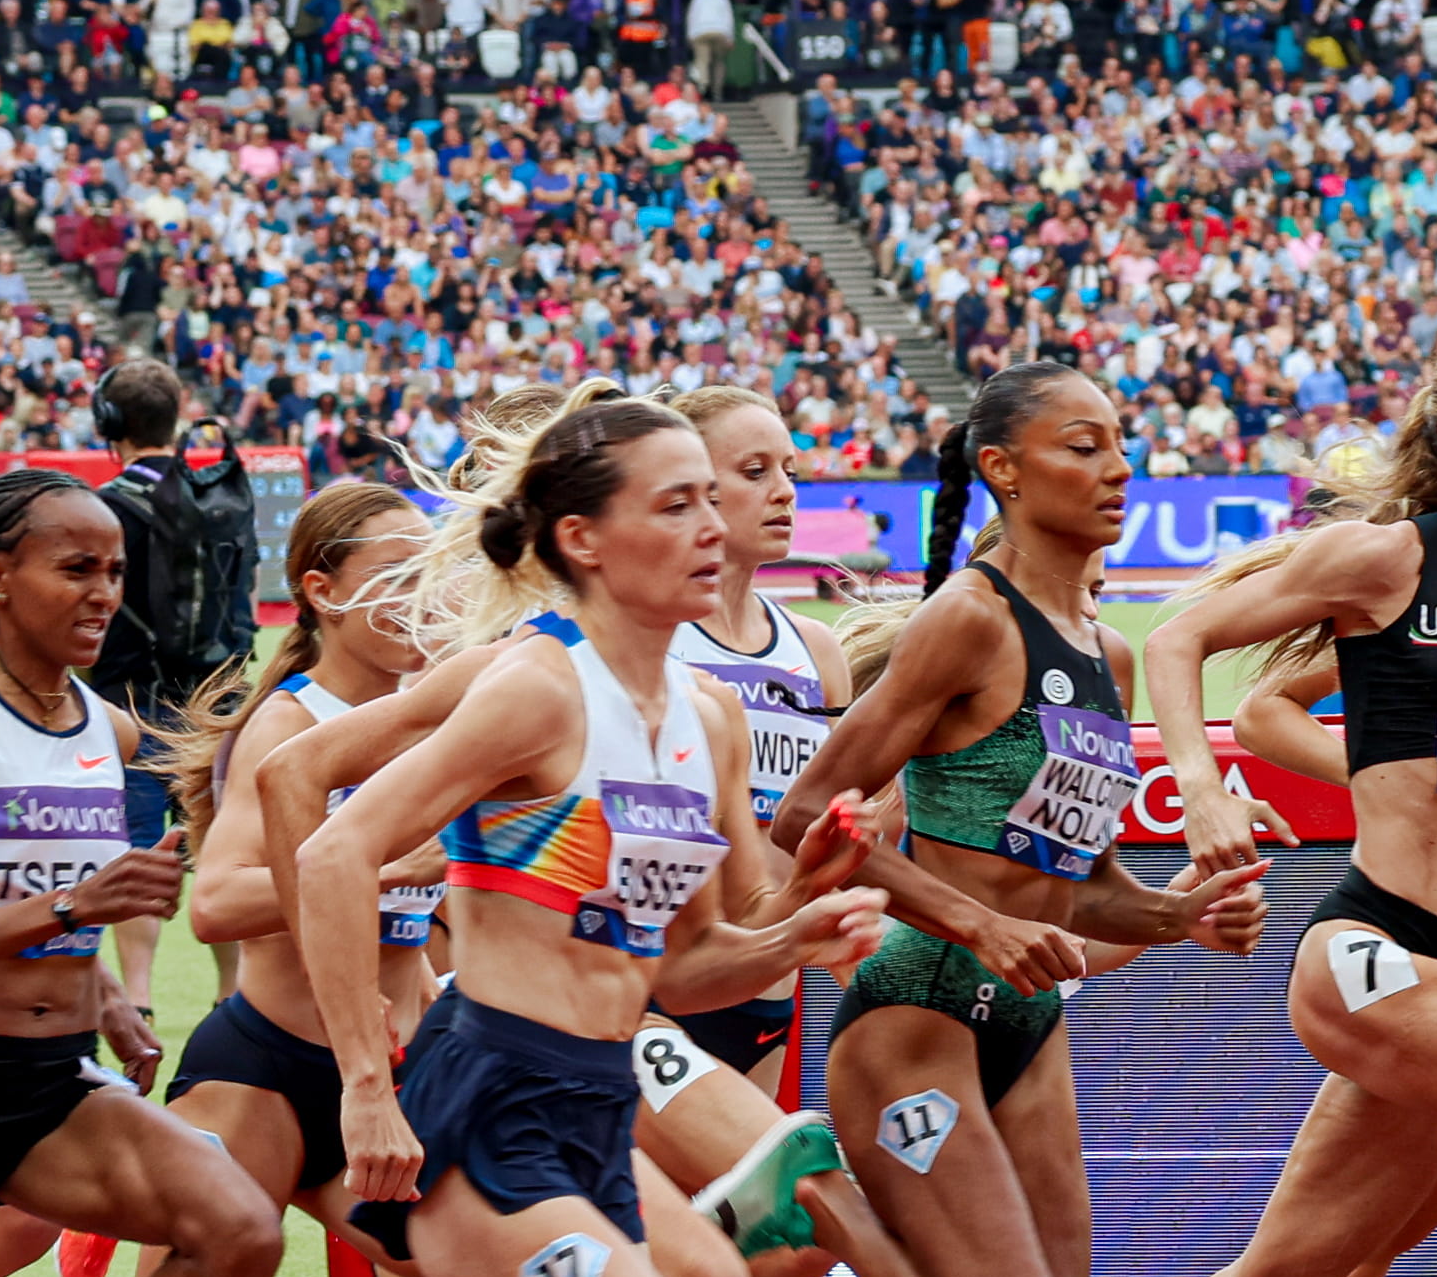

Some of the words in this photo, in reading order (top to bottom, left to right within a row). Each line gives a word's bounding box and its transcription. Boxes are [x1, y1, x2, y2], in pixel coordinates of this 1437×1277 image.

[798, 34, 846, 61] 150
[1347, 939, 1384, 994] 7
[640, 1037, 692, 1087] 8
[891, 1105, 940, 1151] 11
